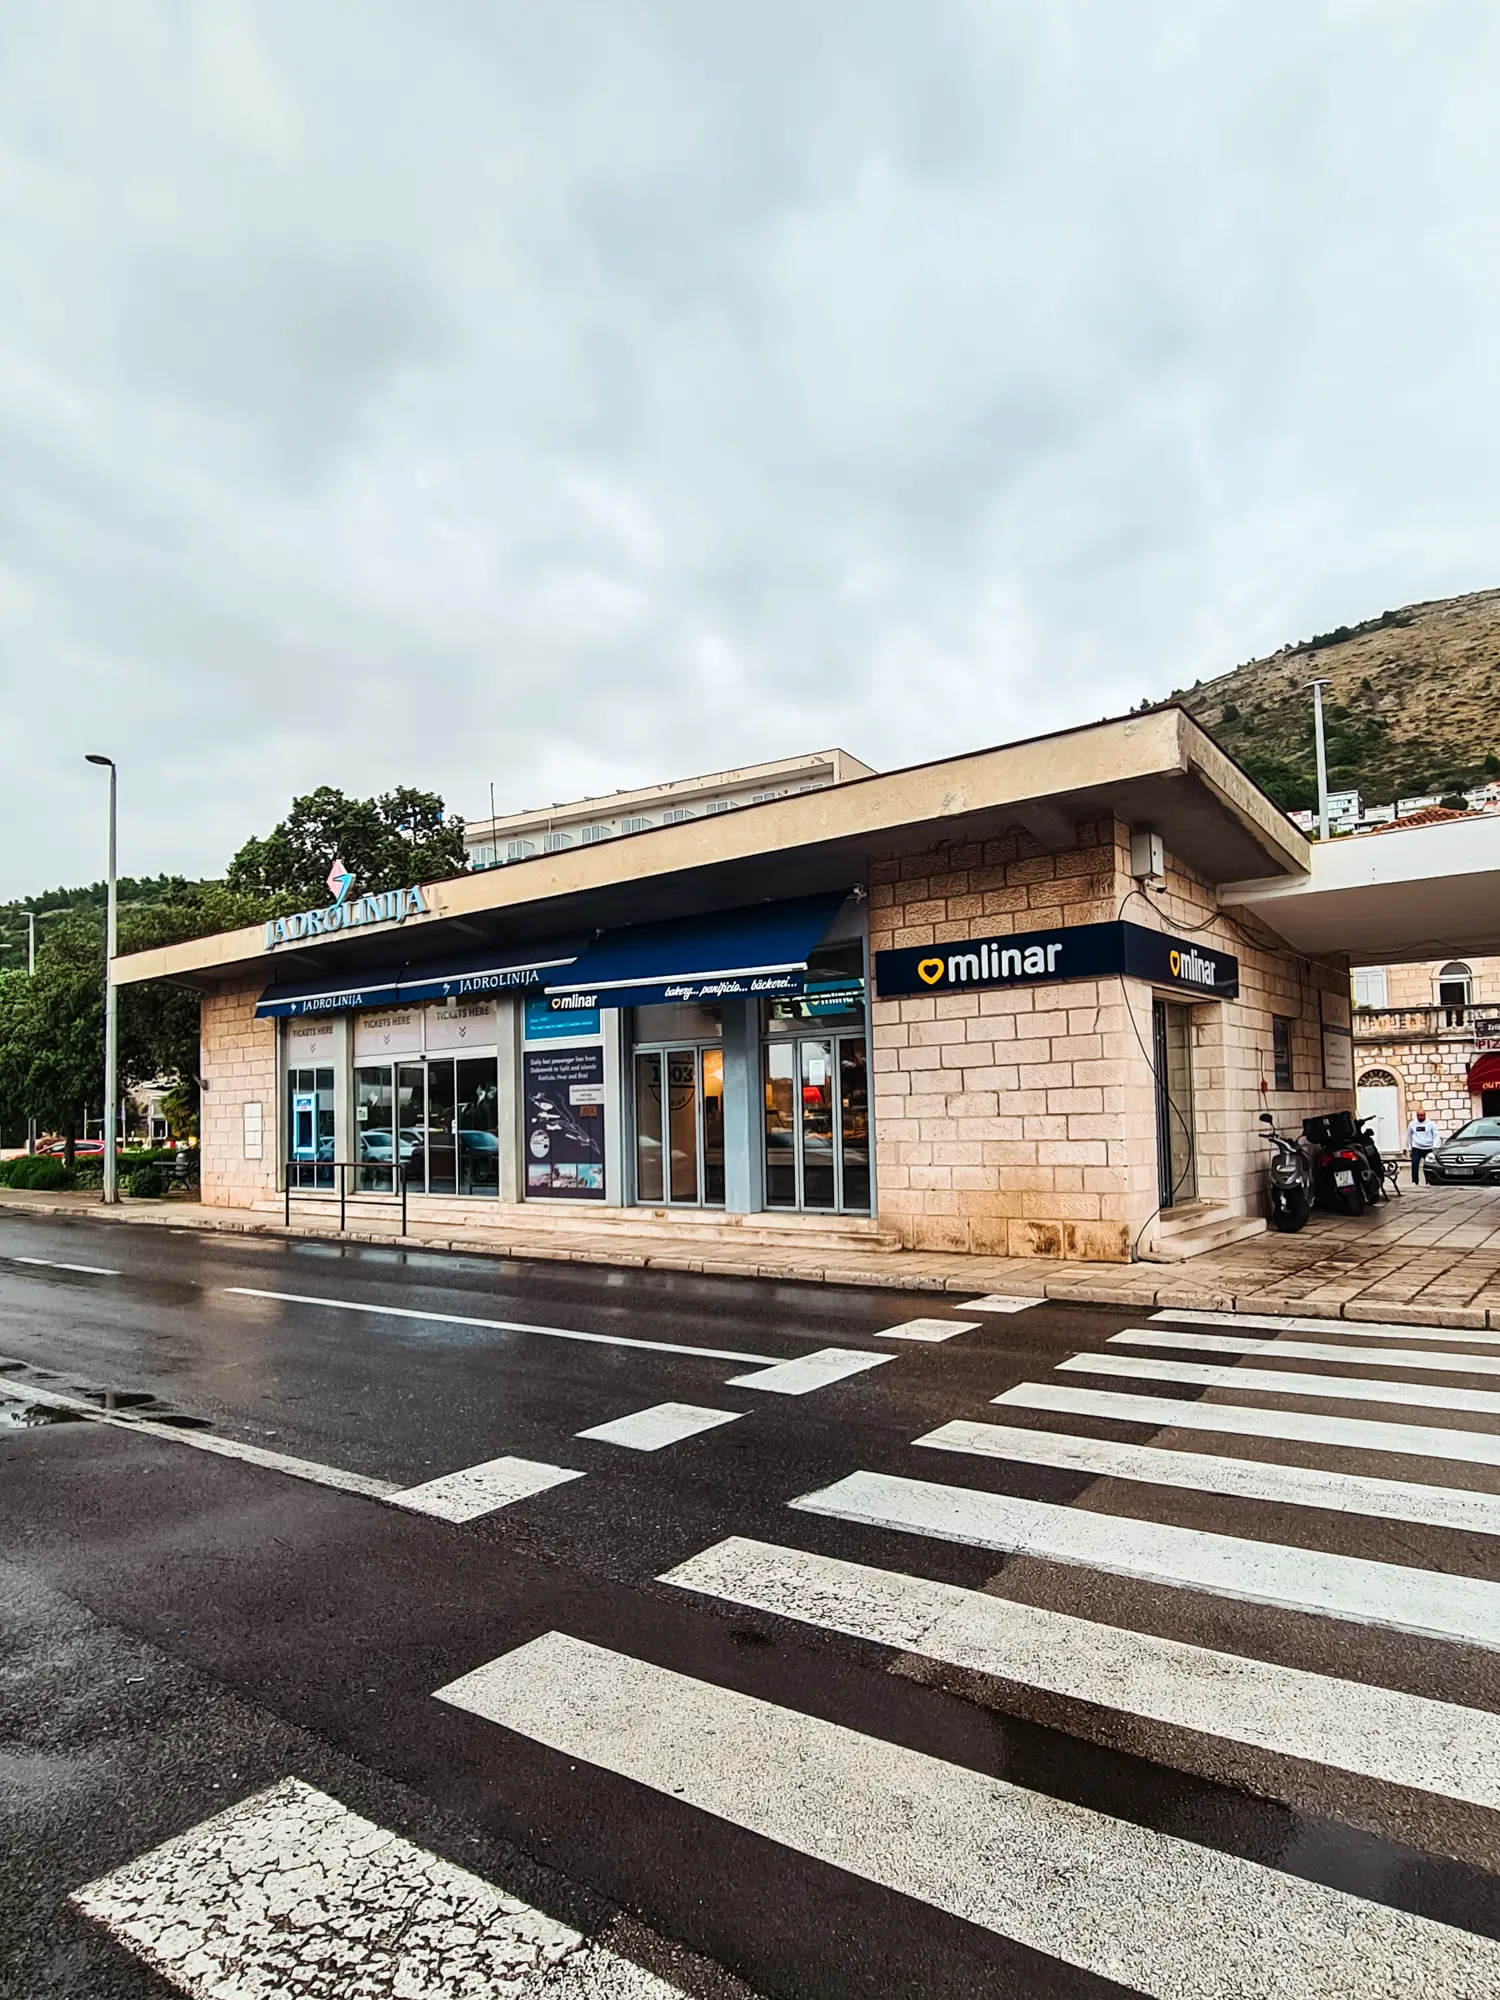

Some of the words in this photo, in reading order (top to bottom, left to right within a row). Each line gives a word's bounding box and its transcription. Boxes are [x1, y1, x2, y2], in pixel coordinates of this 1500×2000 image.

[264, 885, 427, 950] JADROLINIJA
[948, 942, 1062, 983] mlinar
[1180, 948, 1216, 986] mlinar
[459, 969, 540, 994] JADROLINIJA
[302, 993, 363, 1014] JADROLINIJA
[561, 993, 598, 1009] mlinar
[363, 1017, 390, 1029] TICKETS
[392, 1015, 411, 1026] HERE
[435, 1009, 467, 1021] TICKETS
[469, 1006, 490, 1018] HERE
[293, 1027, 316, 1037] TICKETS
[317, 1025, 333, 1036] HERE
[652, 1066, 693, 1082] 103
